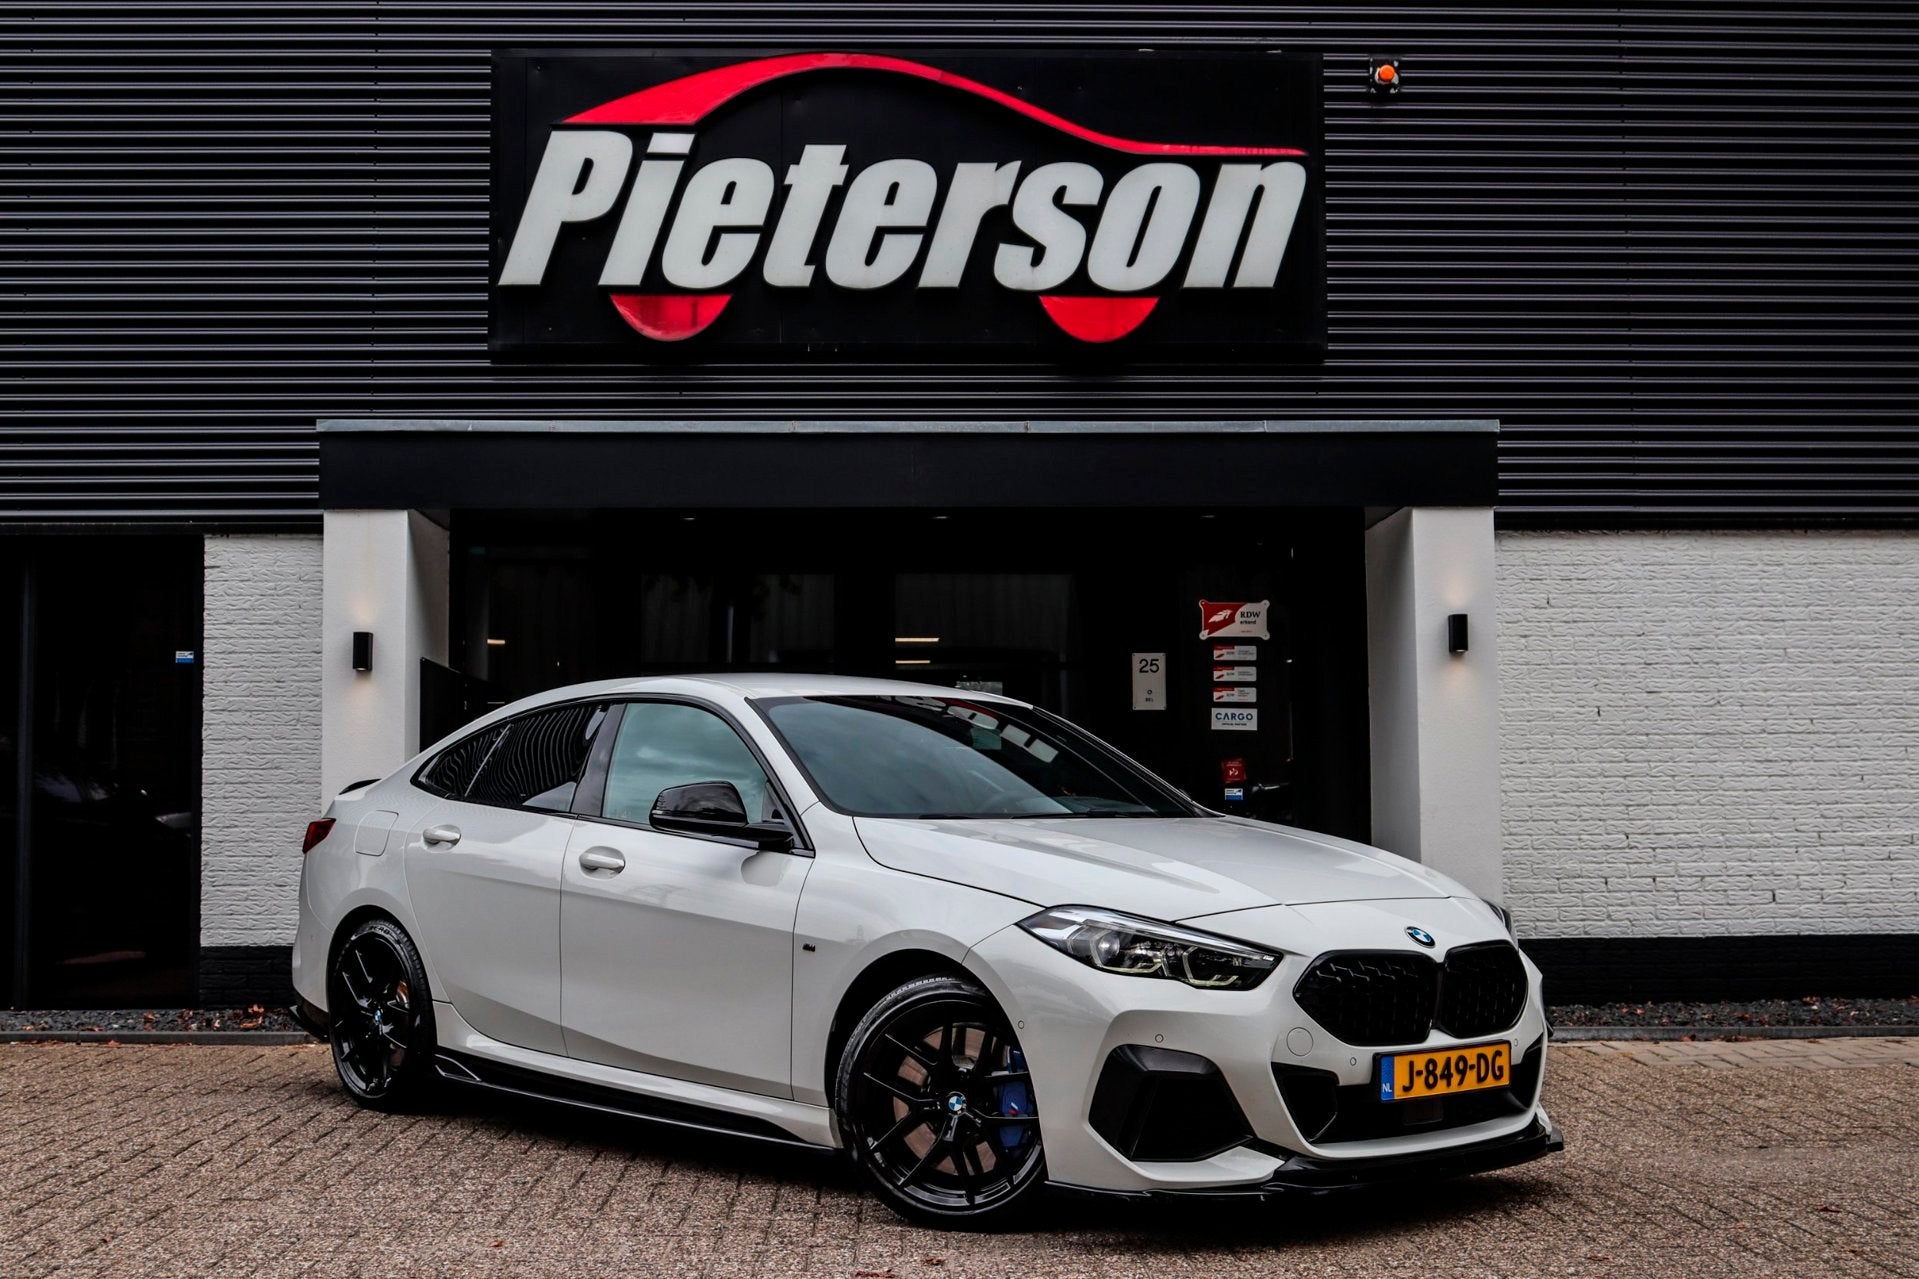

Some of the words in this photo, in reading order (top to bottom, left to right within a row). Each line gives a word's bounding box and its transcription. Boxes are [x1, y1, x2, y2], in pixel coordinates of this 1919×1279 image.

[499, 130, 1307, 292] Pieterson
[1139, 658, 1160, 673] 25
[1215, 712, 1253, 720] CARGO
[1402, 1050, 1504, 1092] J-849-DG
[1382, 1083, 1393, 1093] NL
